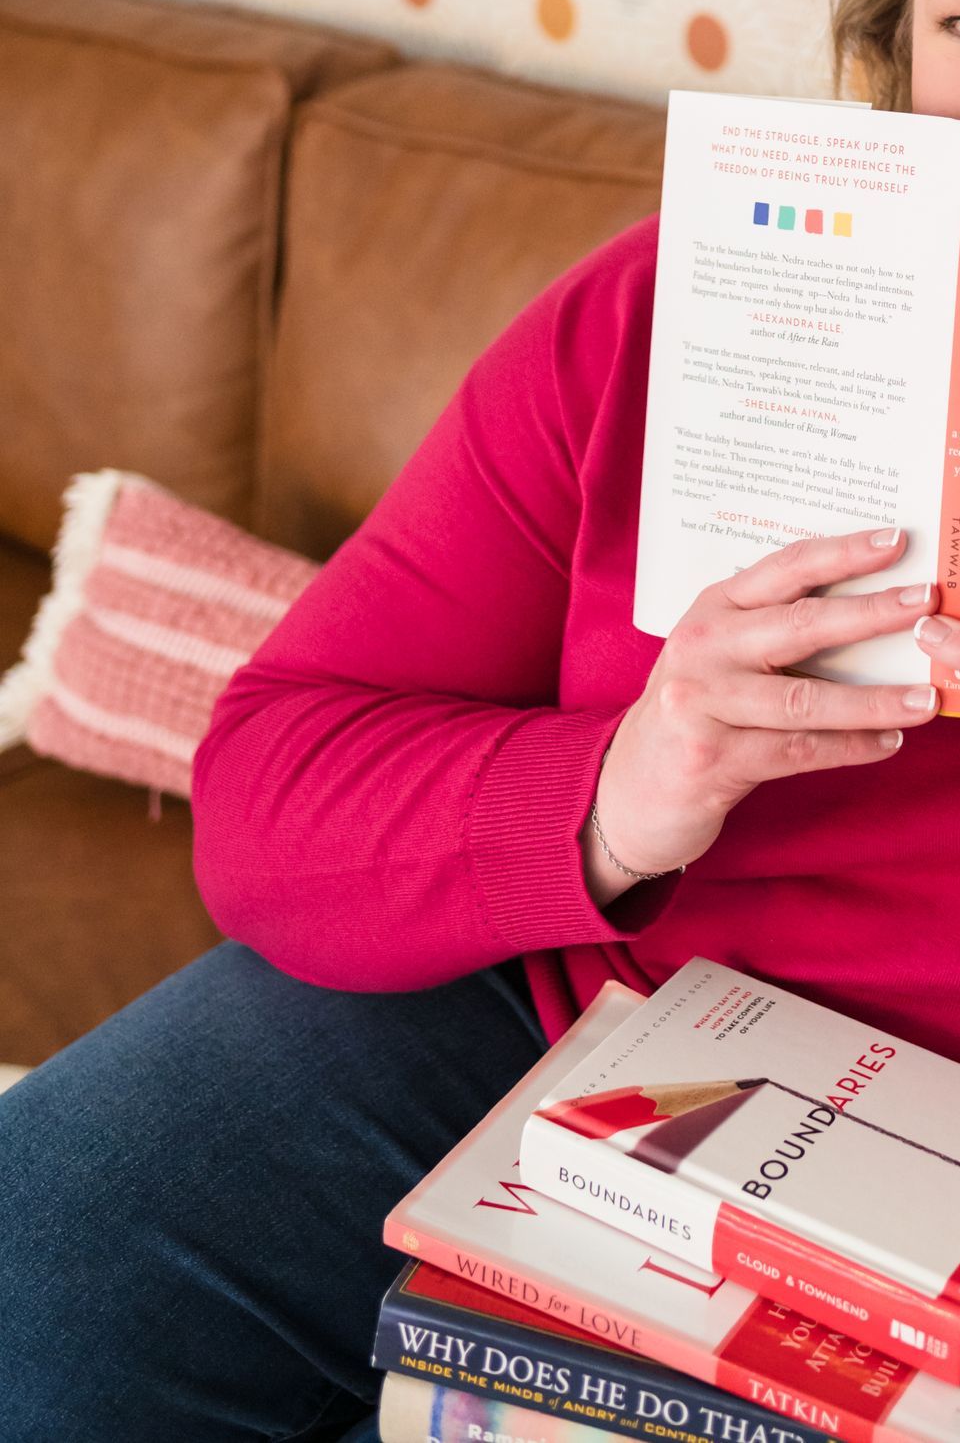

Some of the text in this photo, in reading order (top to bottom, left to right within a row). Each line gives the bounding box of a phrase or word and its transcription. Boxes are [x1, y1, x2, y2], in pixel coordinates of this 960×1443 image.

[711, 143, 735, 154] WHAT
[739, 146, 758, 157] YOU
[795, 153, 818, 164] AND
[822, 155, 890, 172] EXPERIENCE
[895, 164, 915, 175] THE
[722, 125, 740, 136] END
[744, 128, 761, 139] THE
[826, 137, 860, 150] SPEAK
[864, 141, 878, 152] UP
[882, 143, 904, 155] FOR
[713, 161, 908, 194] FREEDOM OF BEING TRULY YOURSELF
[750, 325, 839, 348] author of After the Rain
[719, 408, 744, 421] author
[746, 413, 762, 424] and
[764, 416, 794, 430] founder
[796, 422, 804, 432] of
[830, 428, 856, 441] Woman
[952, 430, 958, 438] a
[751, 516, 779, 530] BARRY
[610, 1031, 650, 1068] MILLION
[653, 997, 687, 1028] COPIES
[688, 973, 712, 994] SOLD
[693, 1014, 712, 1029] WHEN
[718, 996, 729, 1006] SAY
[727, 986, 741, 996] YES
[710, 1017, 725, 1030] HOW
[731, 1000, 743, 1010] SAY
[741, 991, 752, 999] NO
[714, 996, 765, 1041] TO TAKE CONTROL
[739, 1000, 776, 1034] OF YOUR LIFE
[742, 1042, 896, 1201] BOUNDARIES
[559, 1167, 691, 1241] BOUNDARIES
[453, 1253, 642, 1348] WIRED for LOVE
[737, 1252, 780, 1279] CLOUD
[785, 1275, 795, 1287] &
[798, 1279, 869, 1321] TOWNSEND
[398, 1322, 476, 1367] WHY
[482, 1346, 571, 1394] DOES
[580, 1374, 627, 1410] HE
[636, 1389, 689, 1426] DO
[401, 1355, 452, 1378] INSIDE
[458, 1370, 488, 1389] THE
[493, 1382, 544, 1403] MINDS
[548, 1396, 559, 1410] of
[563, 1401, 617, 1422] ANGRY
[620, 1417, 639, 1429] and
[748, 1379, 839, 1433] TATKIN
